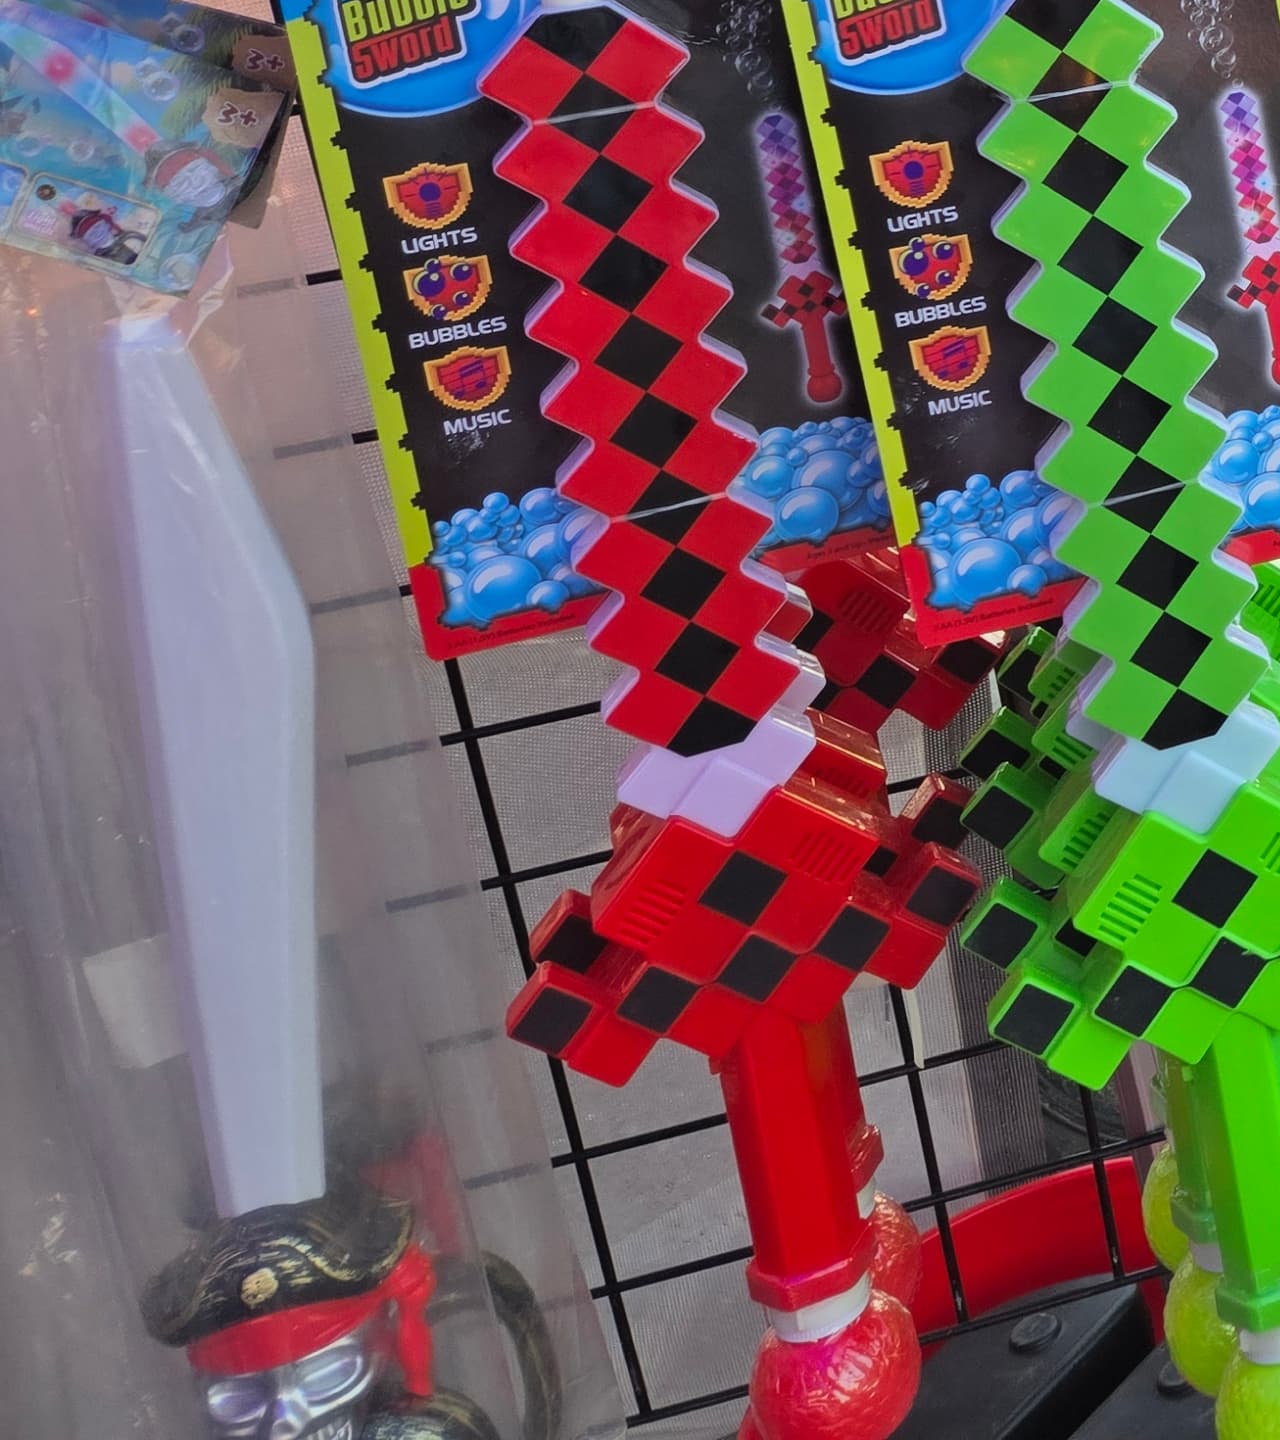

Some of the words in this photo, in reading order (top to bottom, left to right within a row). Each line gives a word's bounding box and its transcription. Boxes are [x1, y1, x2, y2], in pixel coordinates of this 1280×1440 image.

[887, 206, 958, 233] LIGHTS
[401, 227, 478, 254] LIGHTS
[895, 296, 987, 328] BUBBLES
[409, 316, 507, 349] BUBBLES
[928, 390, 992, 416] MUSIC
[443, 409, 512, 435] MUSIC
